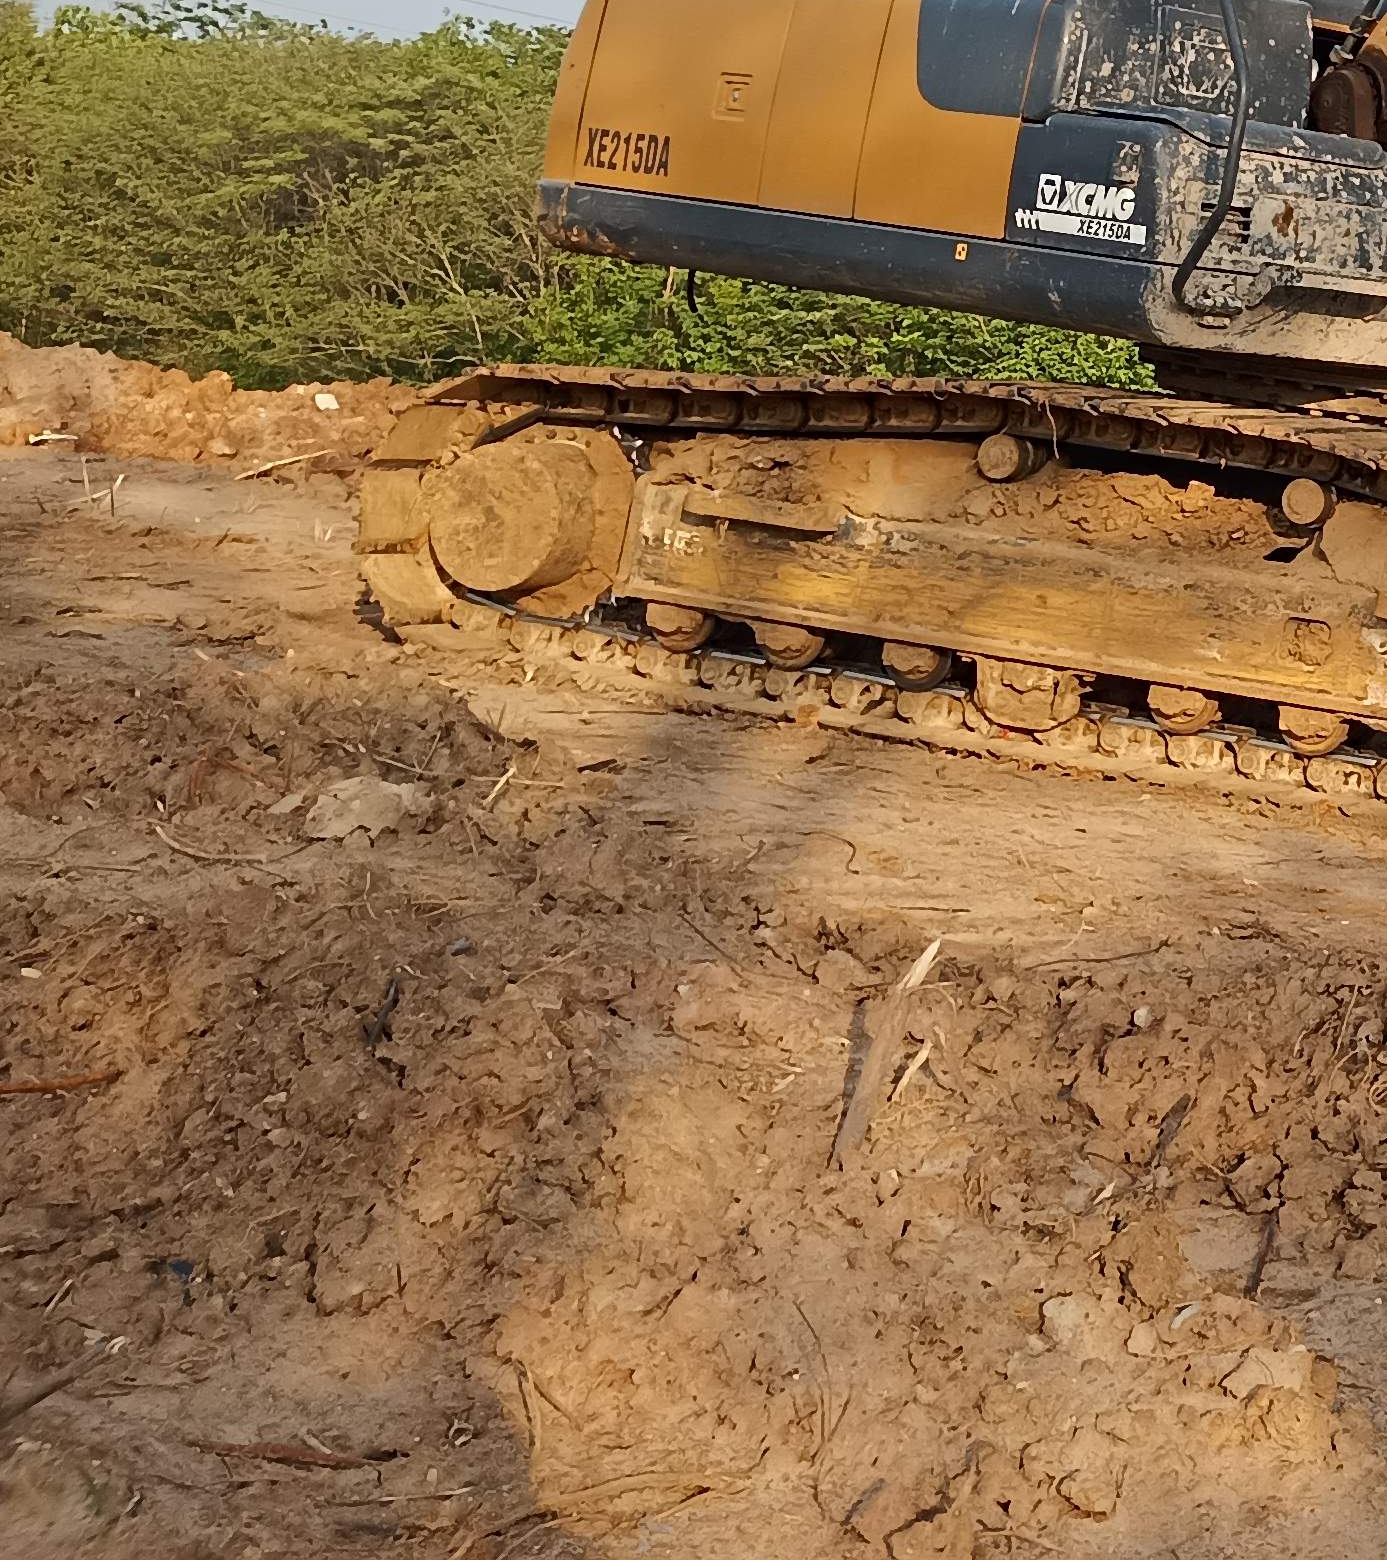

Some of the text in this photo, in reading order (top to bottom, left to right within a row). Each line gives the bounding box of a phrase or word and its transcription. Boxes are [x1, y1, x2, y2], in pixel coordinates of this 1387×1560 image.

[584, 127, 671, 177] XE215DA
[1058, 180, 1136, 220] XCMG
[1076, 219, 1131, 240] XE215DA
